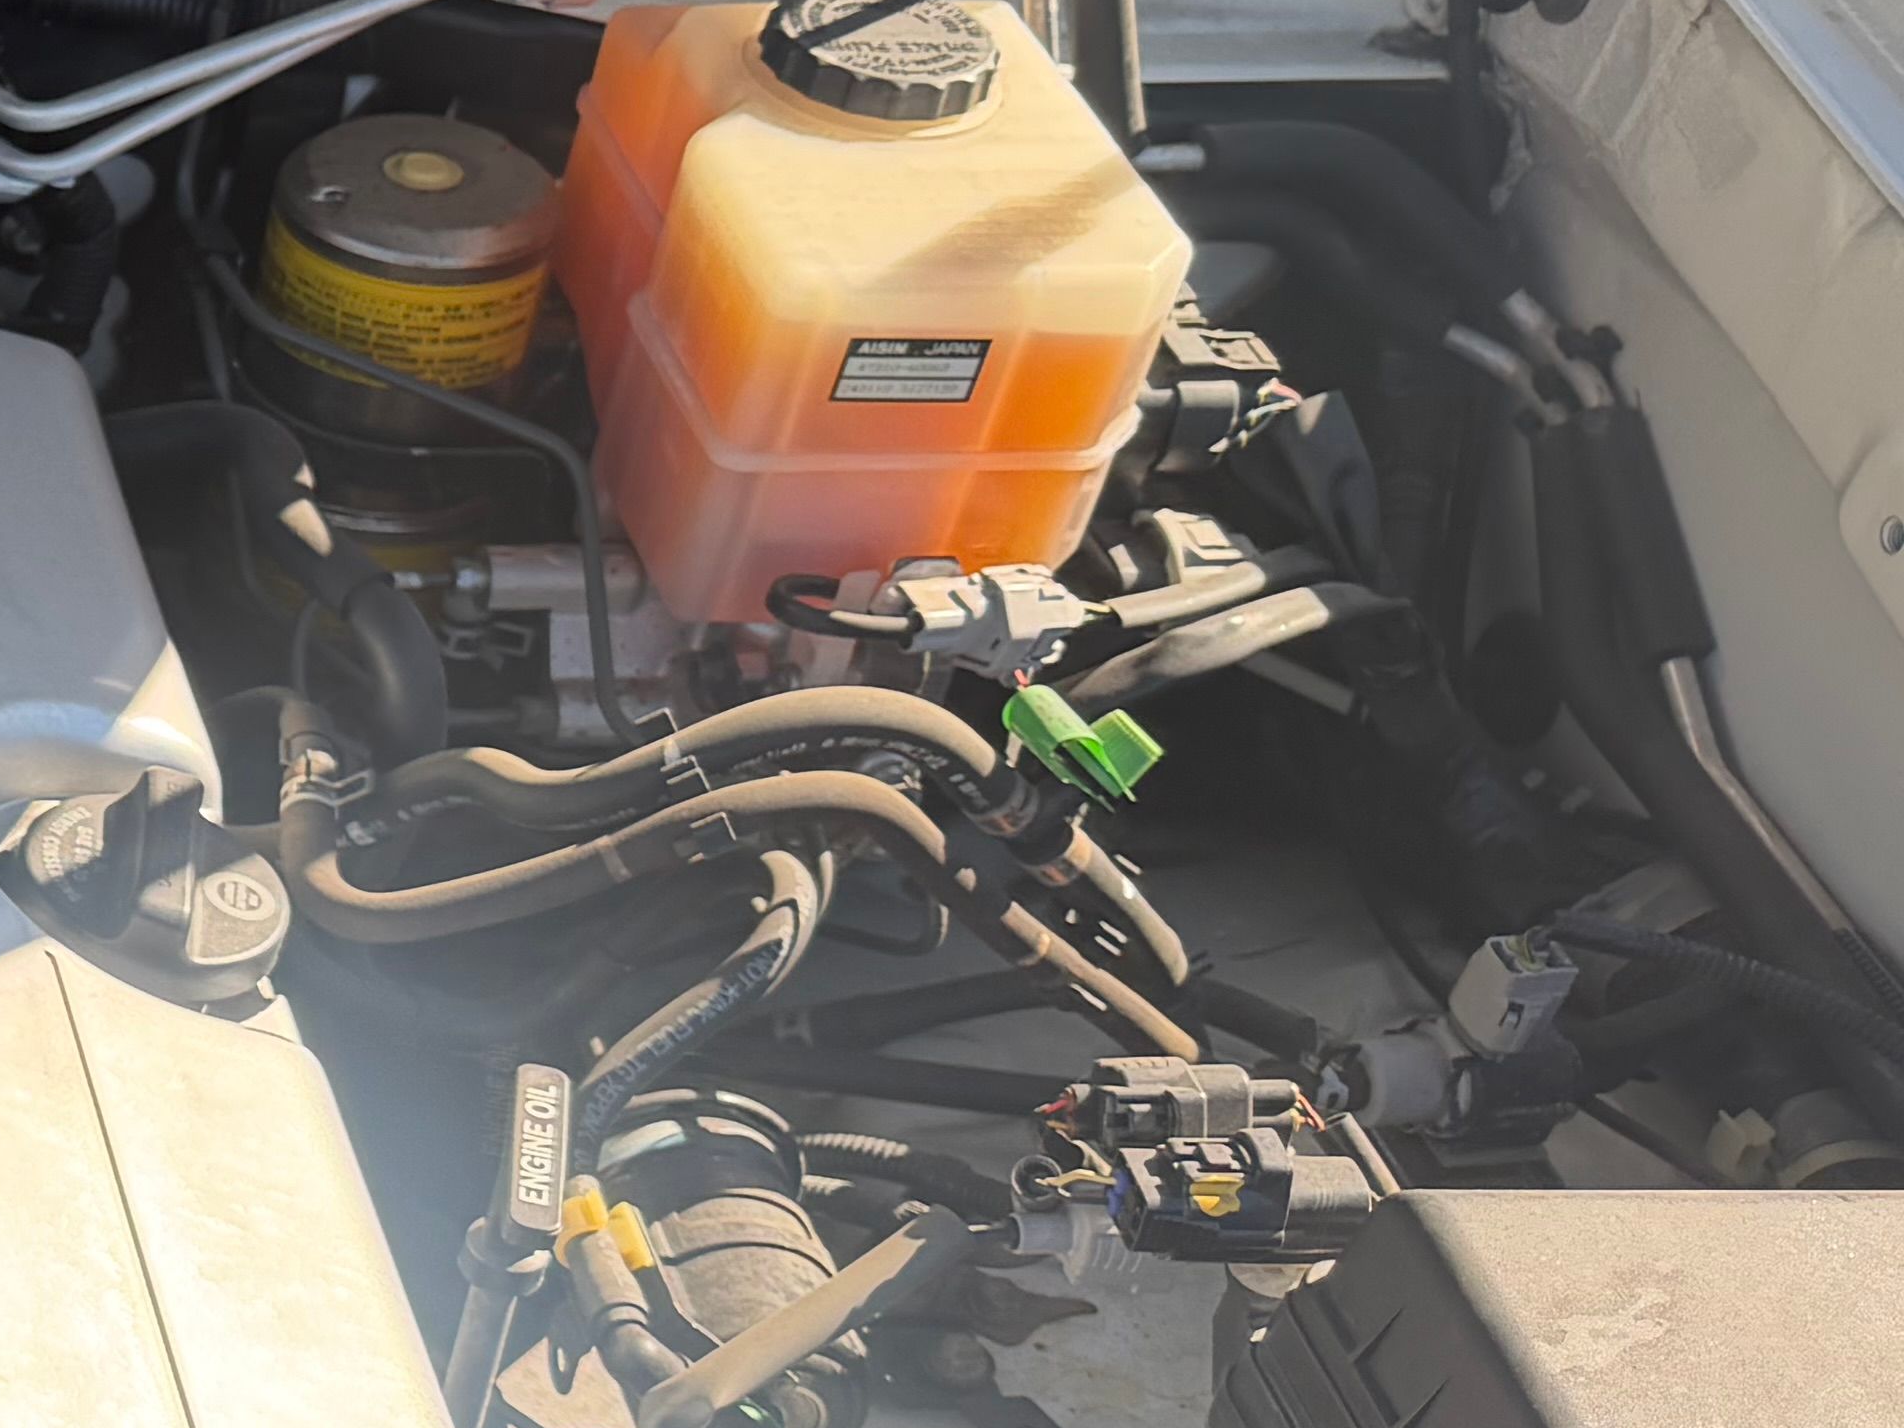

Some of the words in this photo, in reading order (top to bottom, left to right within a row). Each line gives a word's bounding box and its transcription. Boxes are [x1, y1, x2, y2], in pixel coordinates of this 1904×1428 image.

[856, 341, 910, 355] AISIN
[923, 341, 981, 355] JAPAN
[528, 1083, 558, 1118] OIL
[518, 1119, 553, 1206] ENGINE
